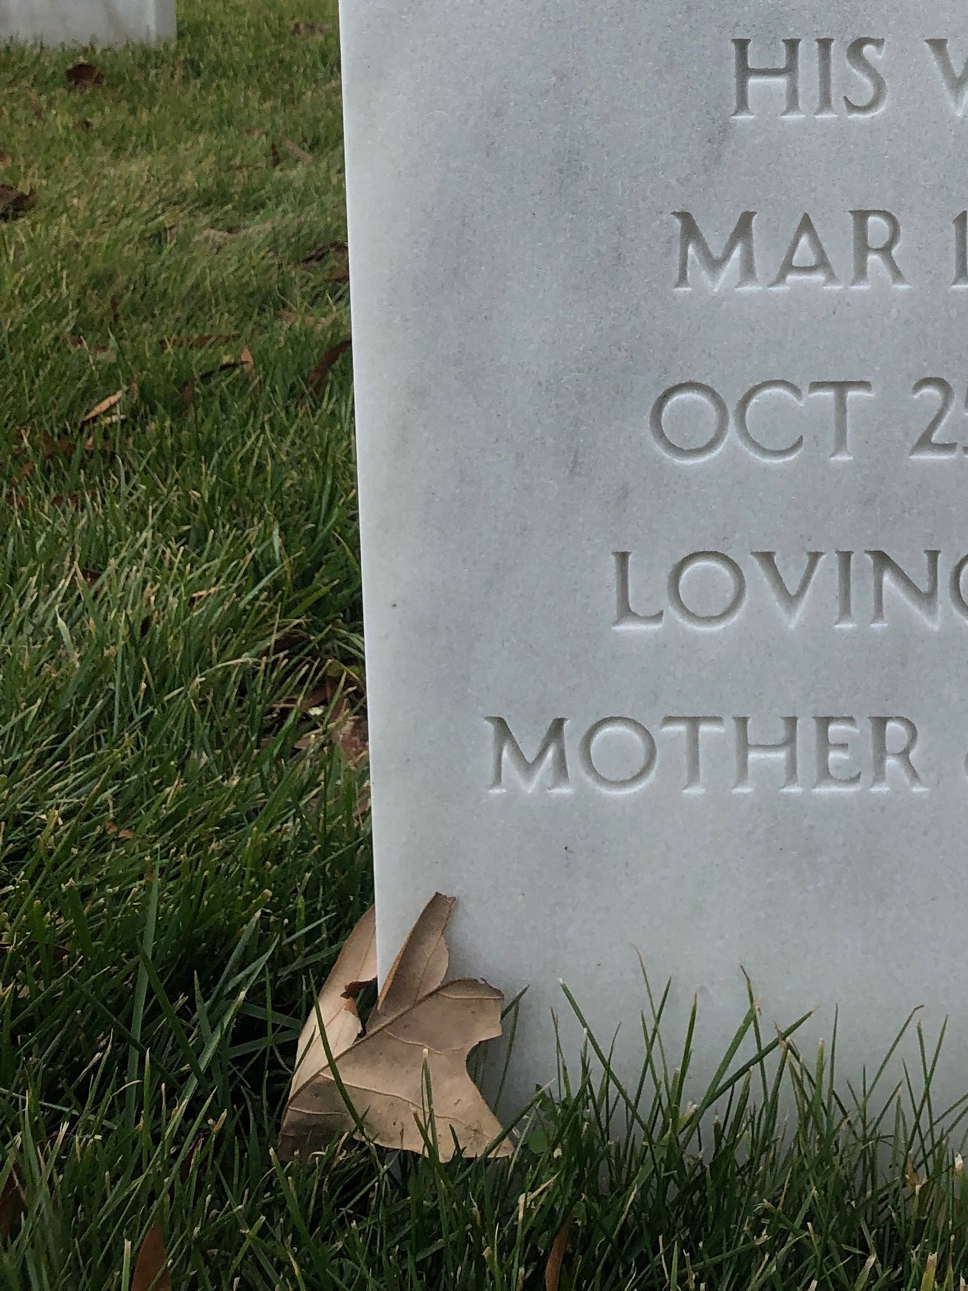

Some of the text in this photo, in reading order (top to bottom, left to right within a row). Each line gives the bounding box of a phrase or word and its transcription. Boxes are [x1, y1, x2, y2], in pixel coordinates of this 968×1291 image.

[732, 35, 888, 118] HIS
[671, 208, 911, 290] MAR
[649, 378, 874, 462] OCT
[483, 714, 925, 793] MOTHER
